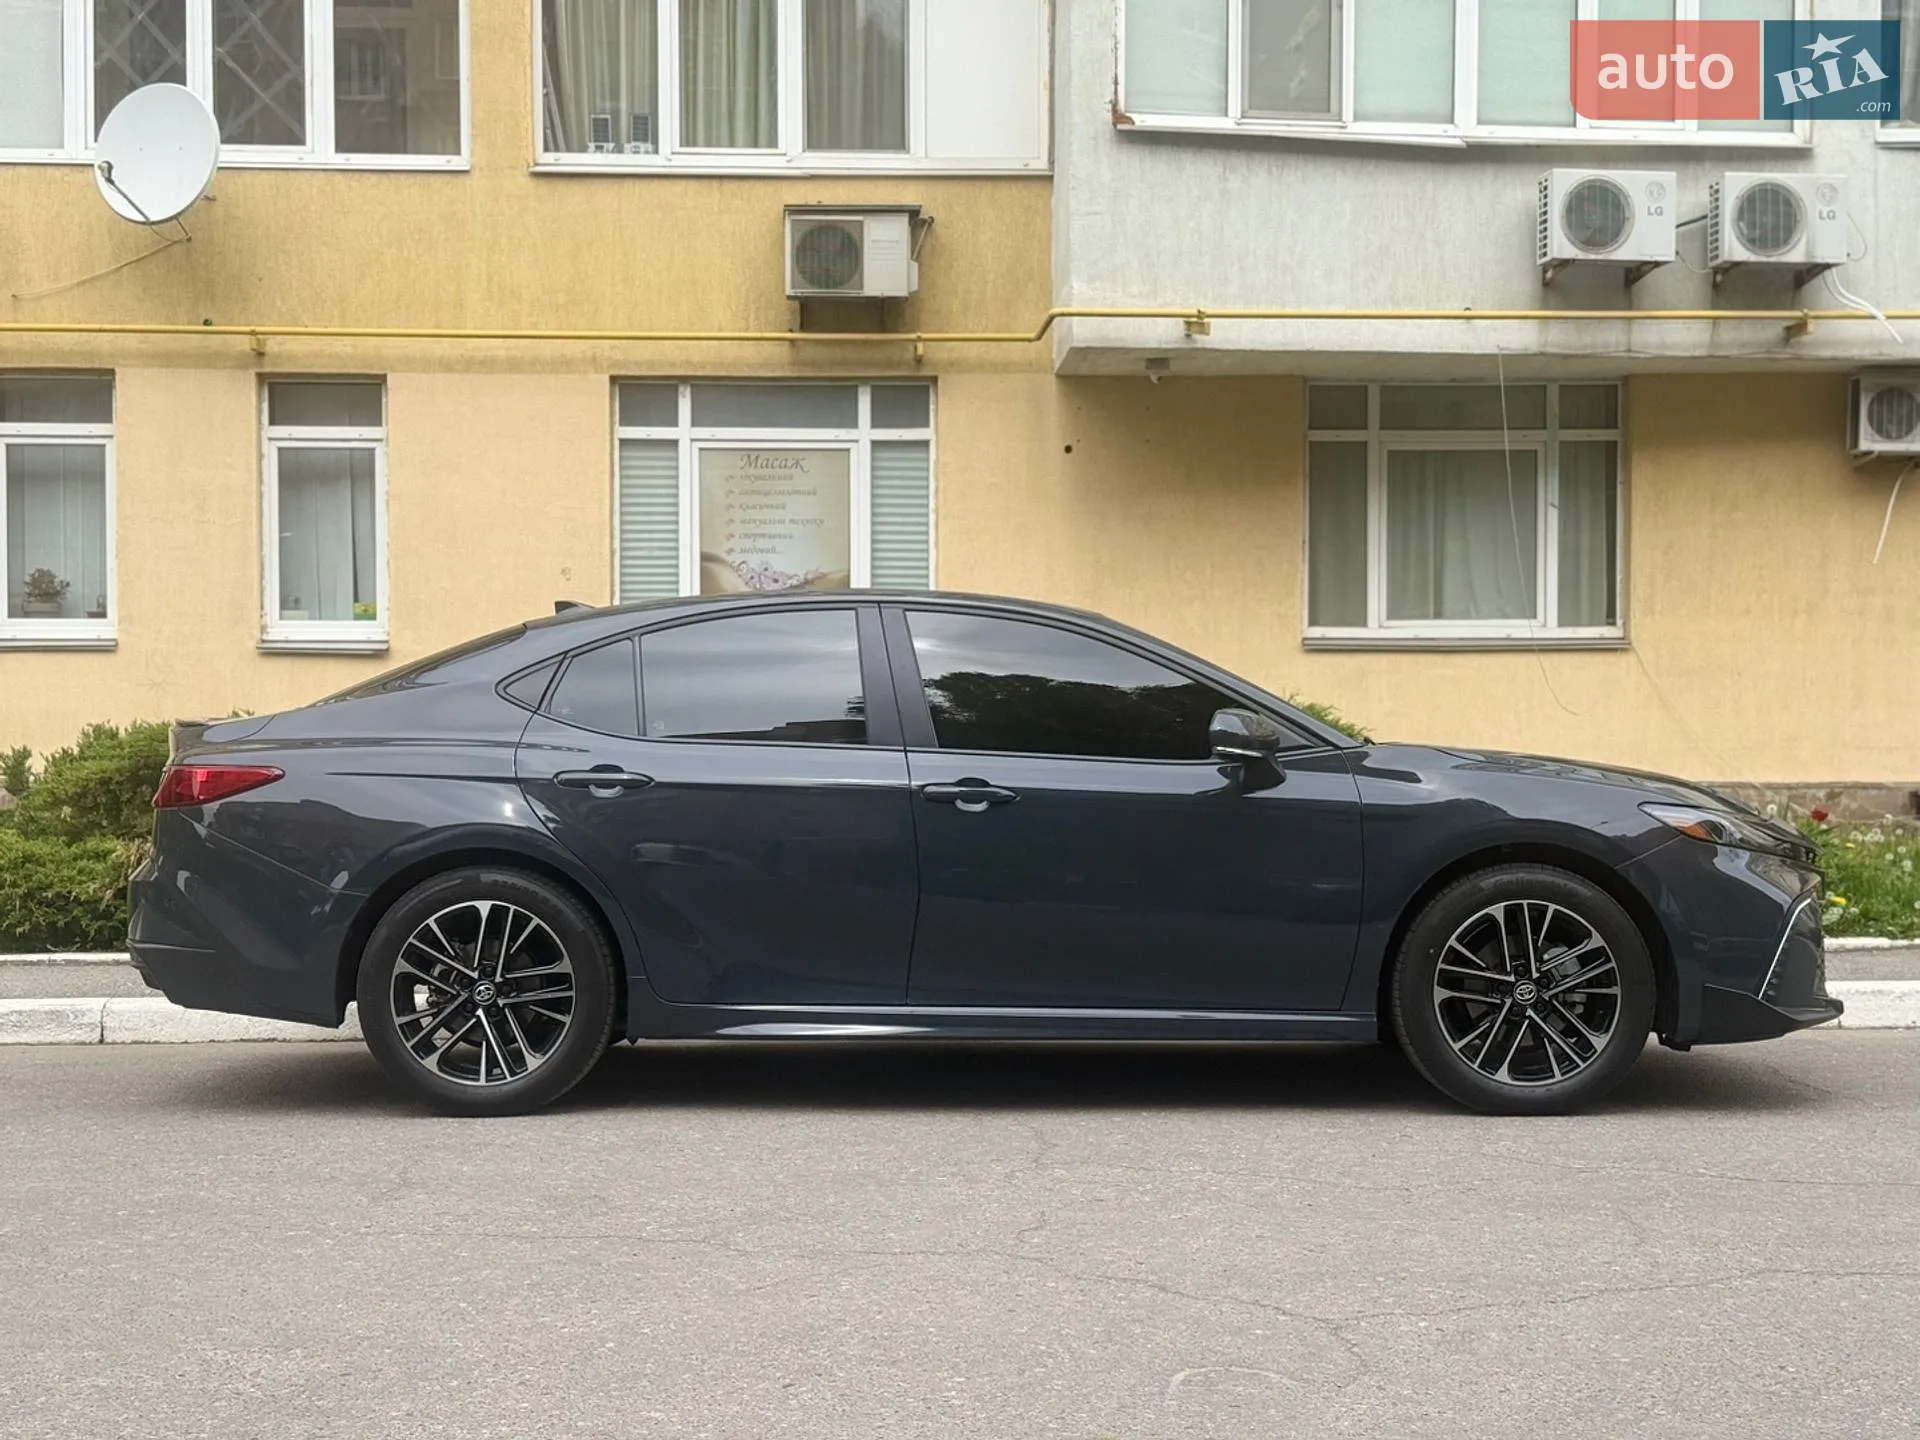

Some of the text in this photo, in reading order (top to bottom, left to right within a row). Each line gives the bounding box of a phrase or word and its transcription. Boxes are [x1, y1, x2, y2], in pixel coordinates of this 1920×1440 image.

[1647, 205, 1664, 217] LG
[1818, 209, 1837, 221] LG
[739, 453, 811, 474] Масаж
